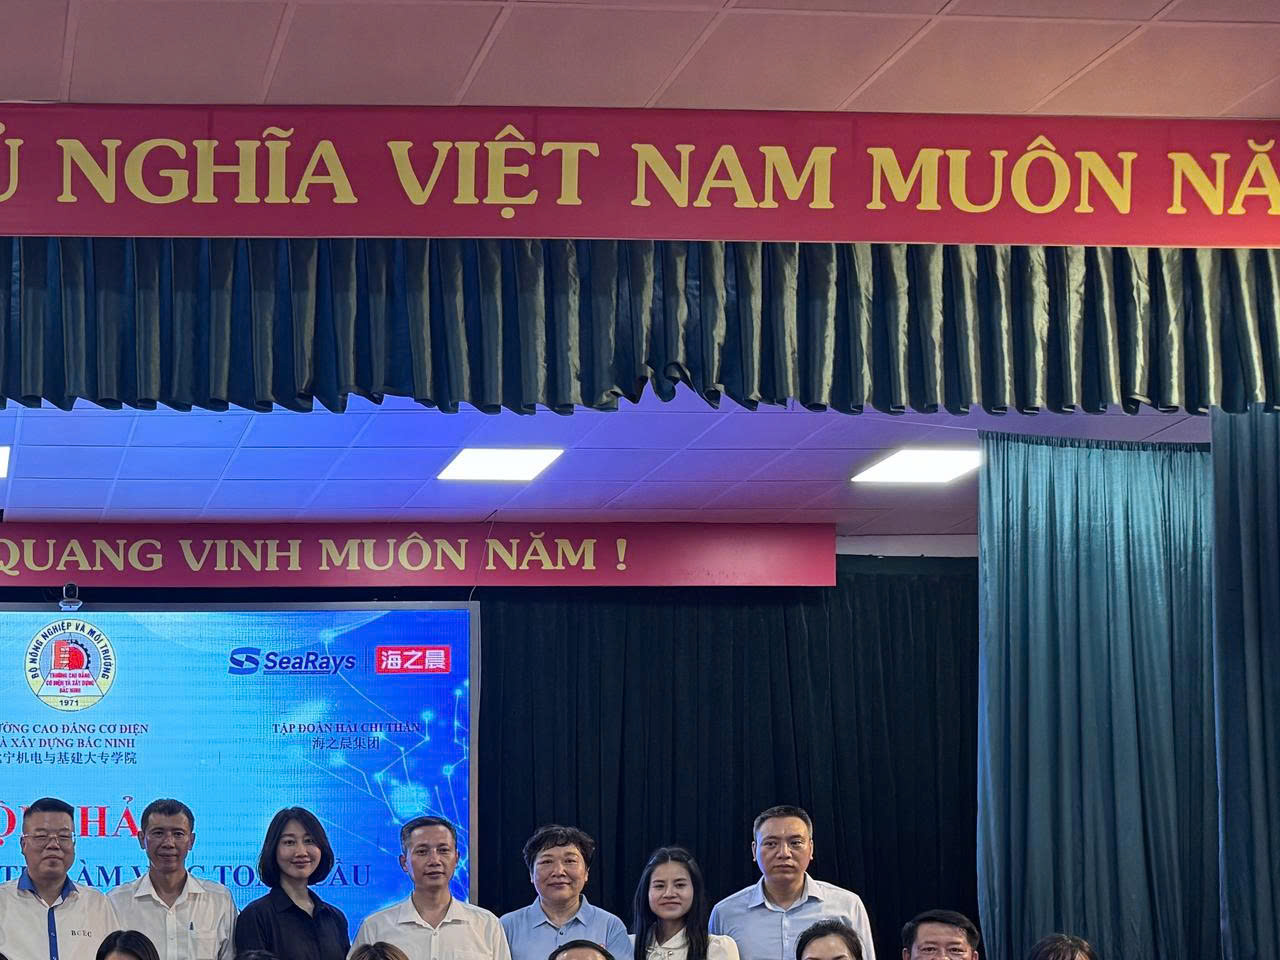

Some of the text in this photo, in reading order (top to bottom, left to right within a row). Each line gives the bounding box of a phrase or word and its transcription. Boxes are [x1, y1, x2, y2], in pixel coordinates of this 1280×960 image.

[56, 126, 358, 205] NGHĨA
[387, 124, 600, 217] VIỆT
[631, 143, 838, 208] NAM
[866, 134, 1136, 215] MUÔN
[179, 540, 301, 571] VINH
[319, 532, 468, 571] MUÔN
[485, 532, 597, 571] NĂM
[616, 539, 628, 571] !
[263, 651, 356, 676] SeaRays
[380, 649, 447, 670] 海之晨
[33, 723, 59, 734] CAO
[99, 723, 117, 734] CƠ
[120, 722, 149, 736] ĐIỆN
[272, 722, 296, 735] TẬP
[298, 720, 333, 733] ĐOÀN
[361, 722, 383, 733] CHI
[10, 737, 37, 748] XÂY
[39, 738, 74, 750] DỰNG
[104, 738, 135, 748] NINH
[312, 736, 380, 750] 海之晨集团
[76, 795, 141, 837] HẢ
[76, 858, 121, 887] ÀM
[317, 858, 371, 886] ẦU
